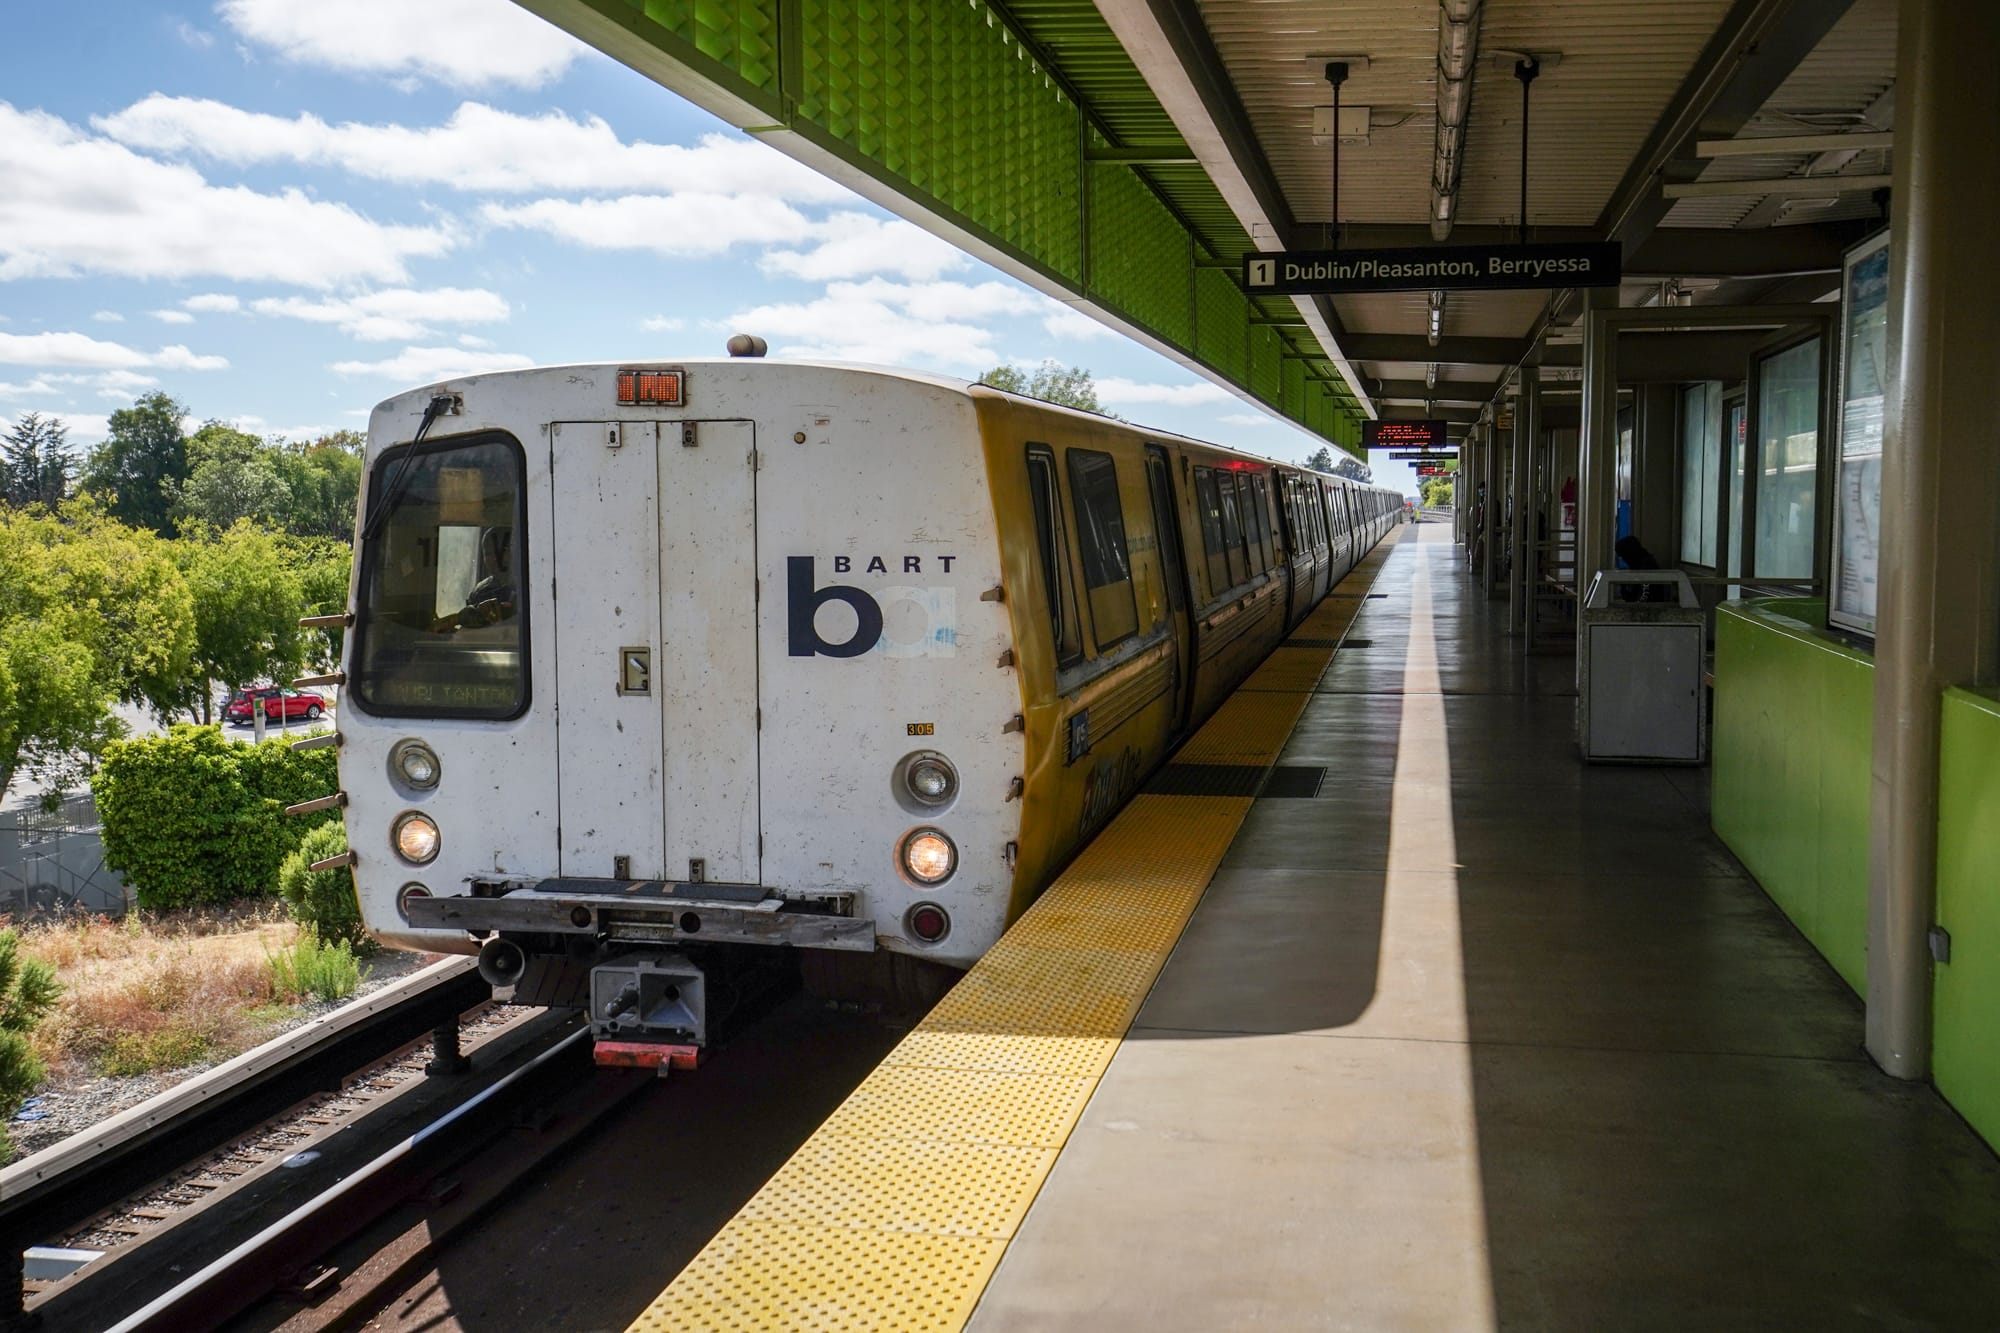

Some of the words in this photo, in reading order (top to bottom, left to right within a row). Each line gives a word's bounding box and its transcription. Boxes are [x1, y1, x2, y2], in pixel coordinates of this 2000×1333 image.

[1256, 263, 1267, 283] 1
[1285, 260, 1480, 281] Dublin/Pleasanton,
[1488, 256, 1591, 278] Berryessa
[834, 555, 957, 574] BART
[908, 723, 934, 735] 305
